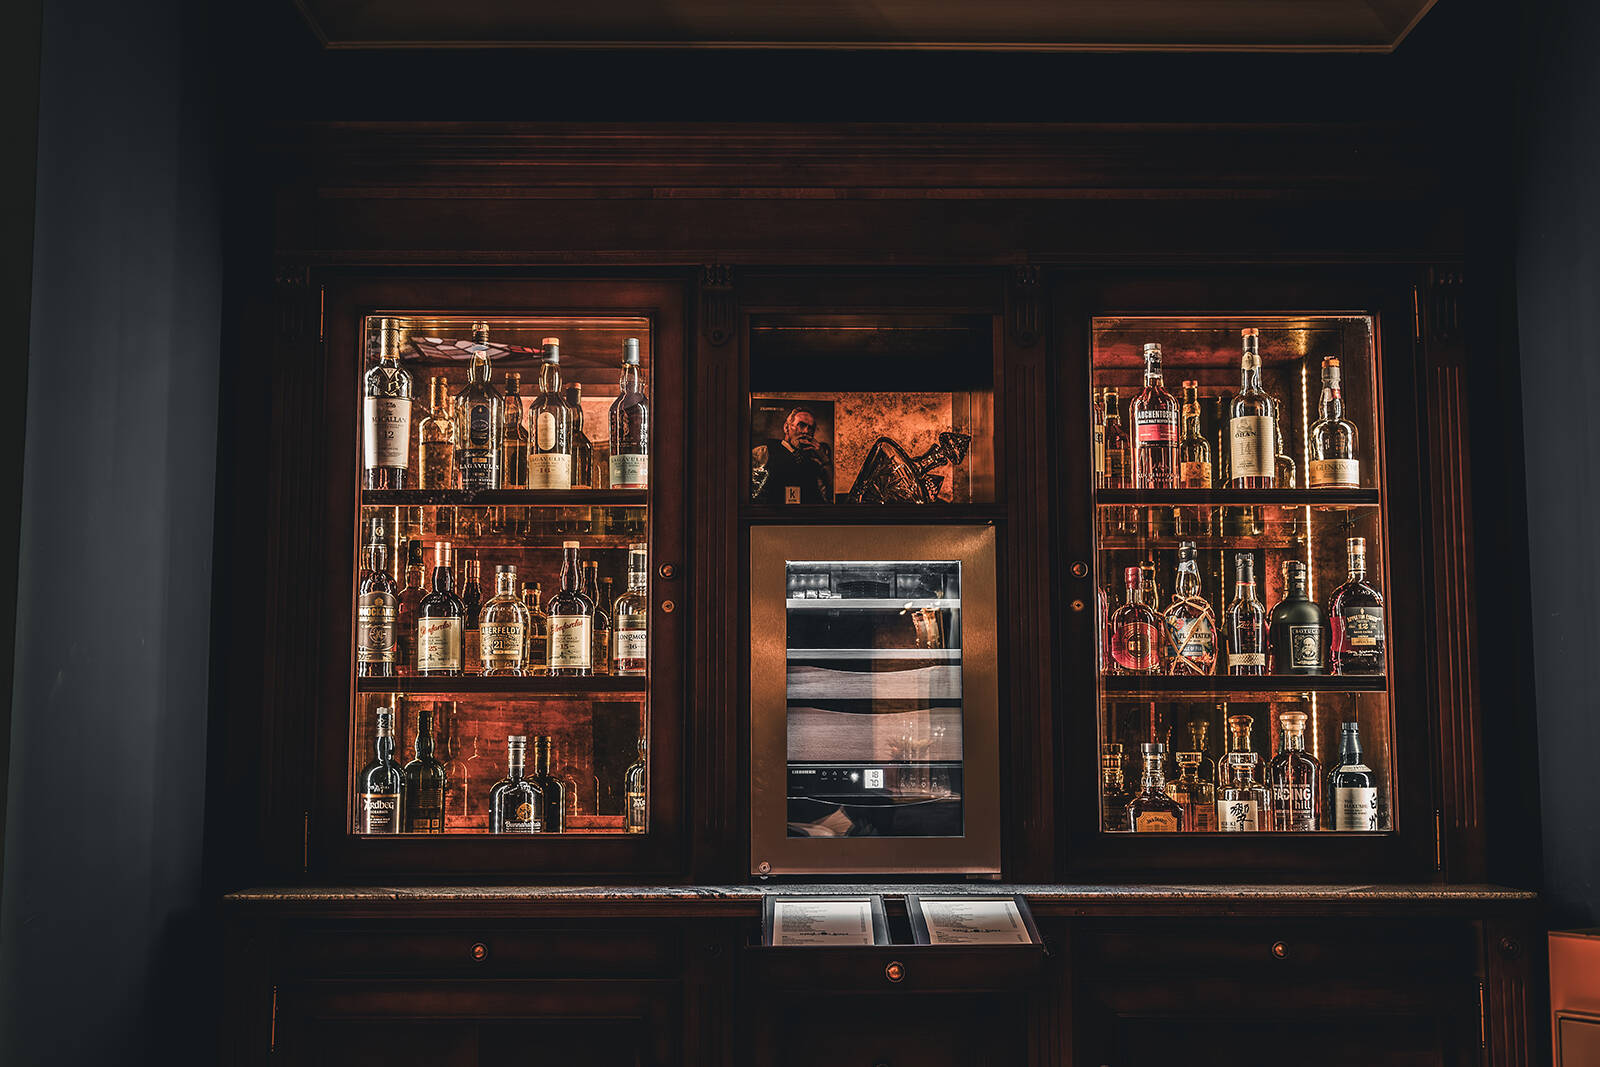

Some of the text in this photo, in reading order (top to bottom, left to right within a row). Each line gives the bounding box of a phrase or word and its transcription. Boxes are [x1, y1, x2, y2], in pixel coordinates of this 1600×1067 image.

[384, 430, 395, 439] 12
[1234, 431, 1257, 439] OBAN
[1240, 441, 1252, 456] 14
[1315, 463, 1358, 471] GLENKIN
[419, 620, 453, 639] Gnfarclas
[481, 626, 521, 635] ERFELDY
[1179, 631, 1212, 639] PLNTATIO
[493, 640, 504, 649] 21
